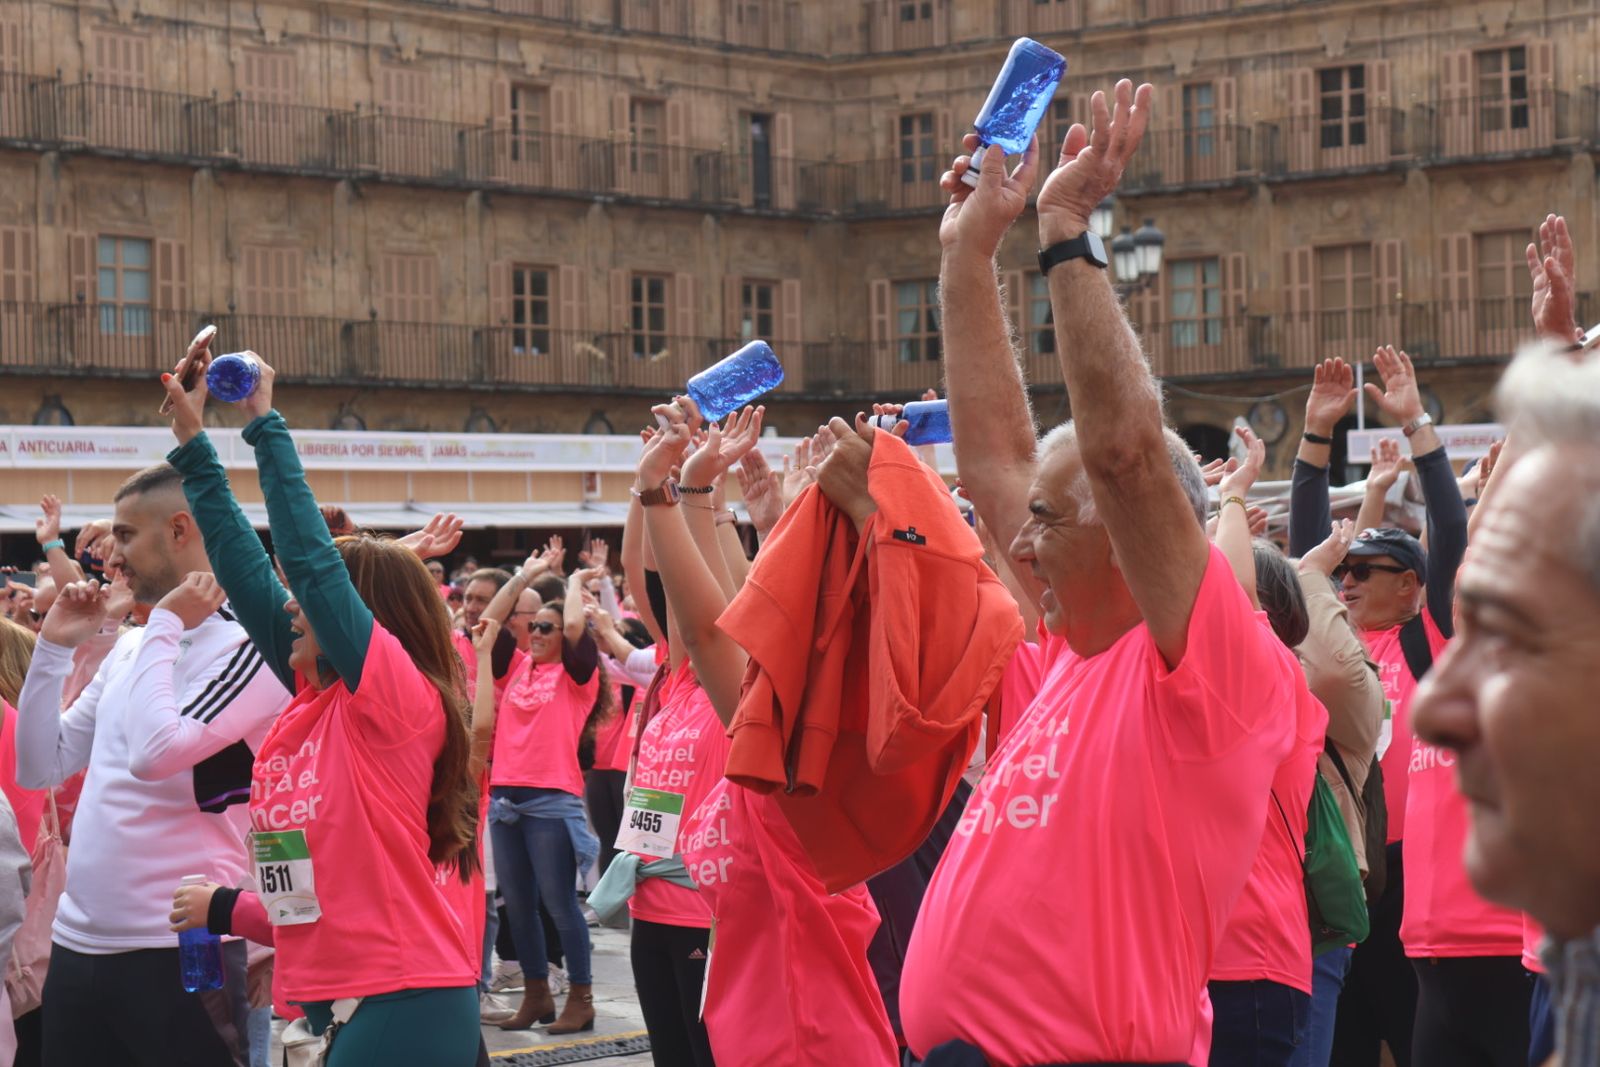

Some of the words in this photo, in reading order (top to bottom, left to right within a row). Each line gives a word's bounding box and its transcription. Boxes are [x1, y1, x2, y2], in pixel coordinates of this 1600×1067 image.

[18, 440, 95, 453] ANTICUARIA
[351, 444, 374, 456] POR
[378, 445, 424, 457] SIEMPRE
[675, 743, 696, 762] el
[630, 810, 663, 833] 9455
[704, 818, 731, 848] el
